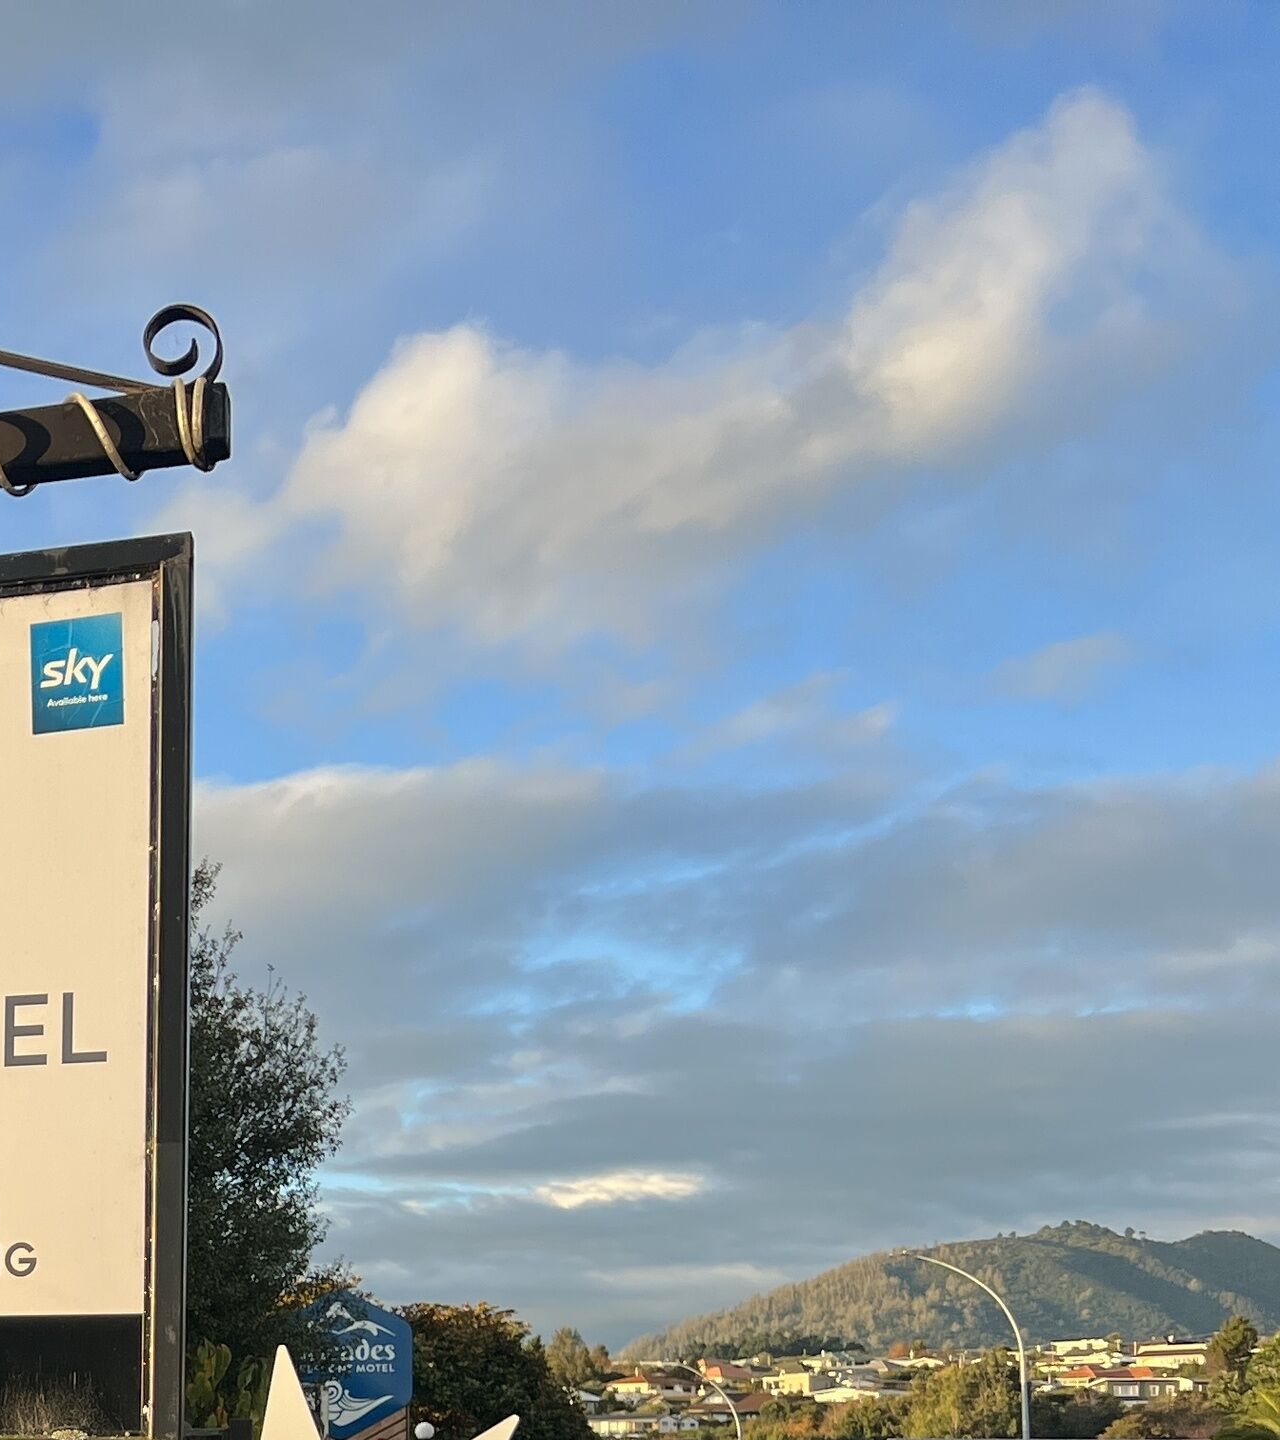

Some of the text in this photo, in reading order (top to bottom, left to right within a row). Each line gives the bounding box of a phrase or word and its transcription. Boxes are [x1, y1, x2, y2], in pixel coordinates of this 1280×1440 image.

[40, 647, 114, 690] sky
[47, 693, 109, 708] Available here
[355, 1363, 396, 1373] MOTEL
